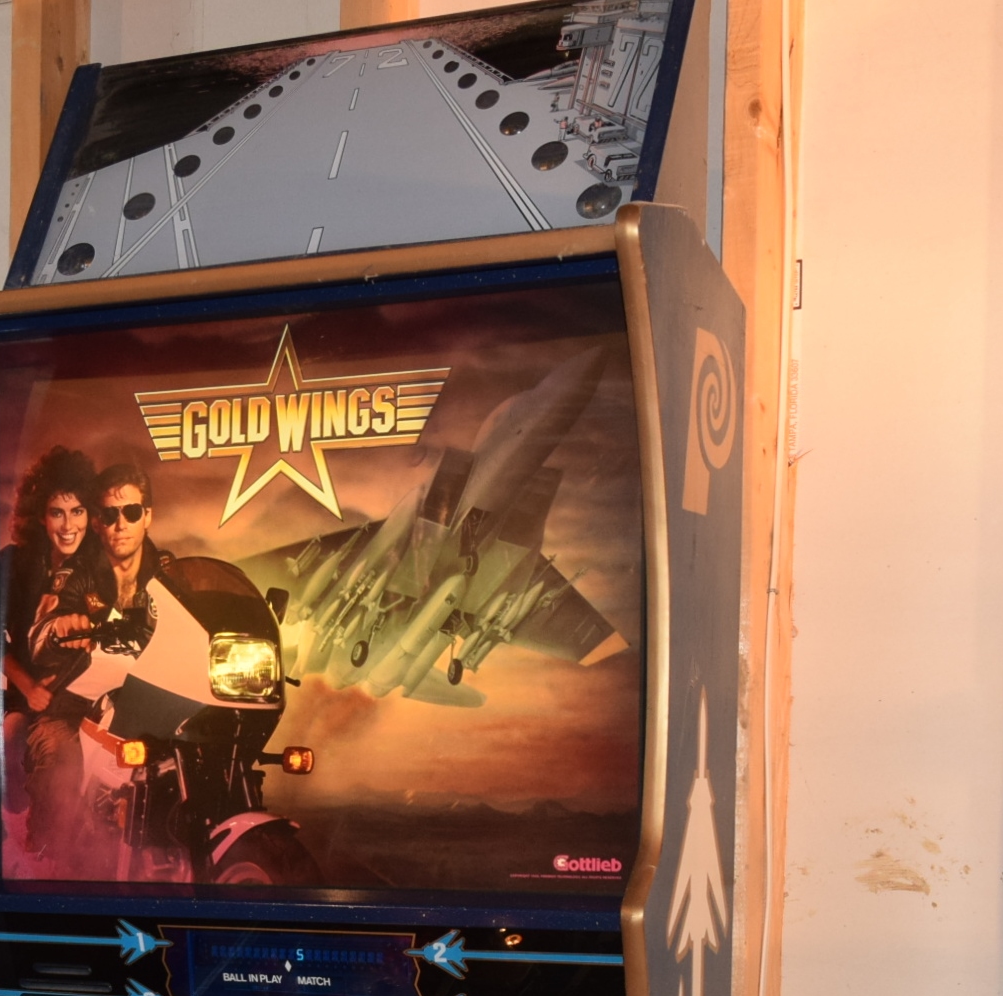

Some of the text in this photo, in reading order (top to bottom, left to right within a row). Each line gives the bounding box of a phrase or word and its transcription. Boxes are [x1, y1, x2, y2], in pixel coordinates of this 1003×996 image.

[789, 383, 799, 419] FLORIDA
[182, 385, 396, 459] GOLD WINGS
[553, 854, 622, 872] Gottlieb
[136, 932, 146, 952] 1
[432, 942, 448, 963] 2
[222, 973, 283, 984] BALL IN PLAY
[297, 976, 331, 986] MATCH
